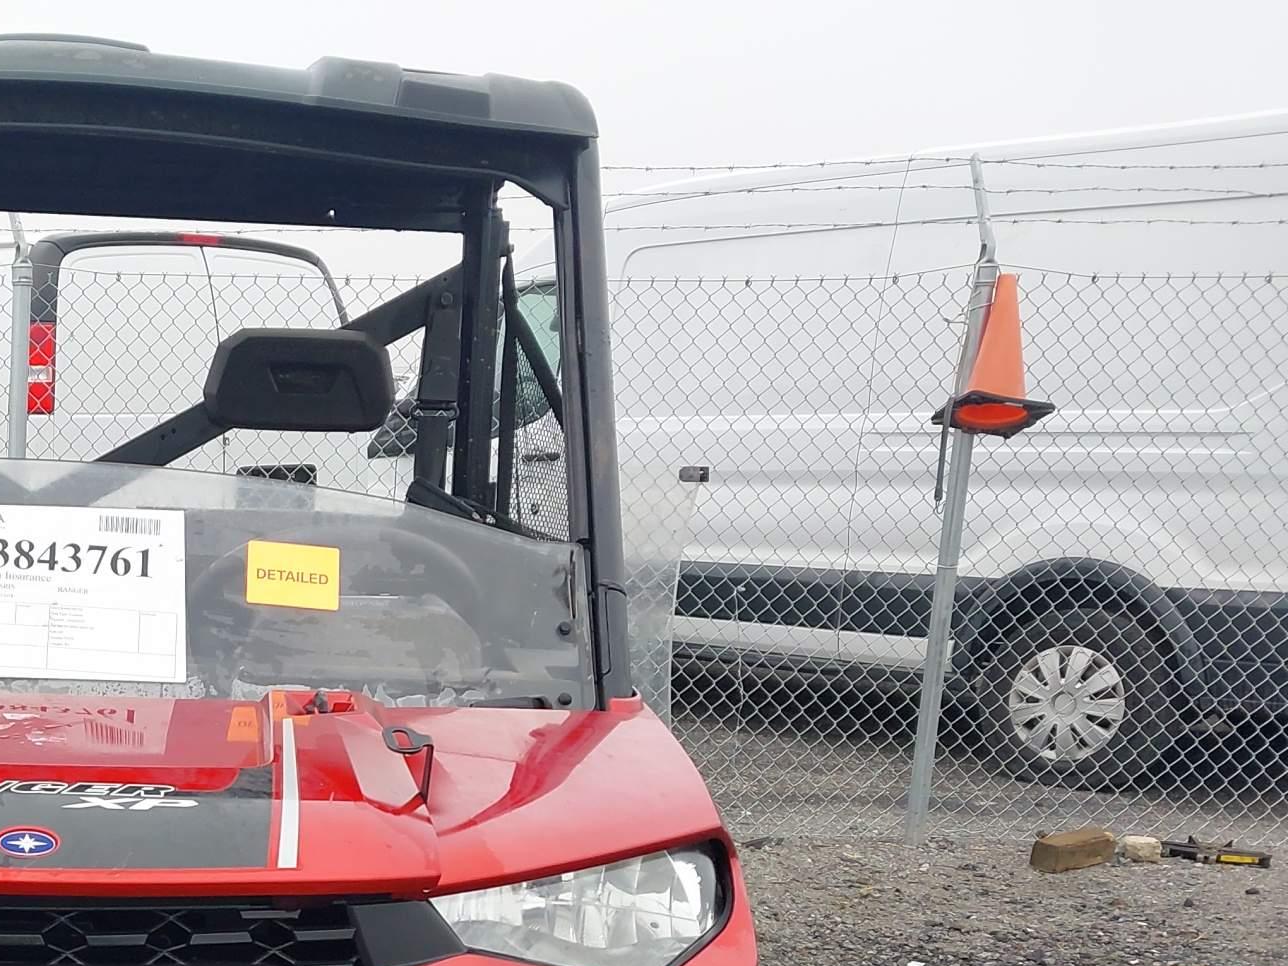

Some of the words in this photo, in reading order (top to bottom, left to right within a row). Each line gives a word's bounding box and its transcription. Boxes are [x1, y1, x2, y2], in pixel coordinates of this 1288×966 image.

[5, 571, 52, 582] Insurance
[256, 567, 329, 585] DETAILED
[61, 796, 200, 811] XP
